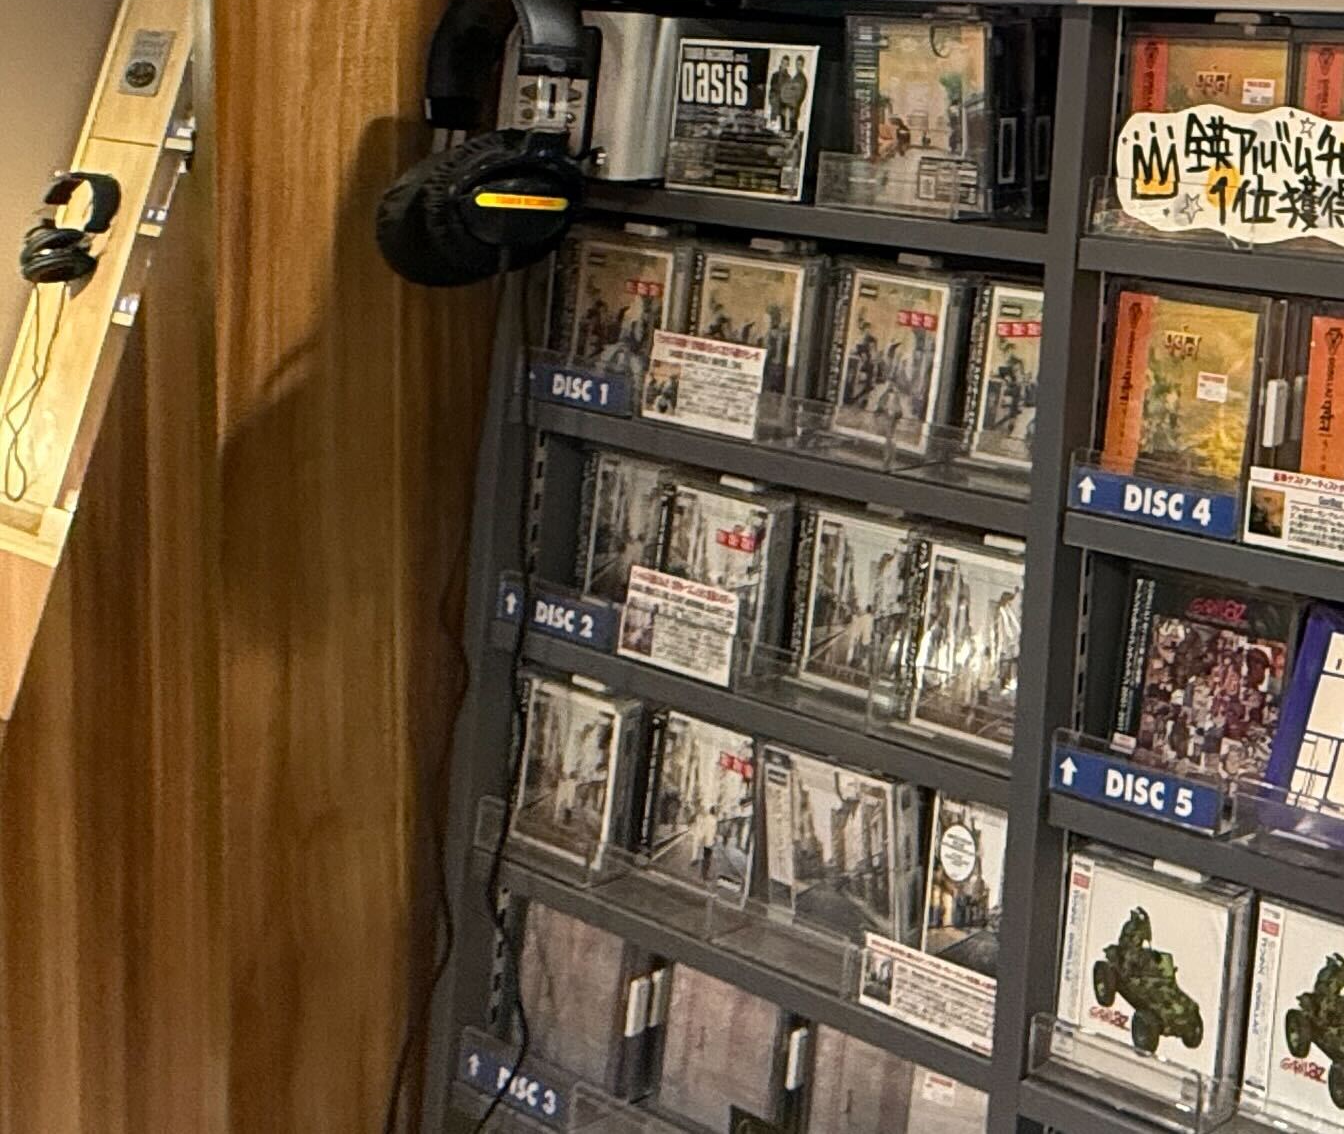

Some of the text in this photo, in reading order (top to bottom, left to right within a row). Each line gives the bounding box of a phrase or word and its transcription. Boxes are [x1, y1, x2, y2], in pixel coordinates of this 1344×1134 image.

[552, 372, 594, 403] DISC
[1123, 484, 1213, 526] DISC 4
[533, 599, 595, 639] DISC 2
[1105, 769, 1194, 818] DISC 5
[542, 1089, 557, 1115] 3
